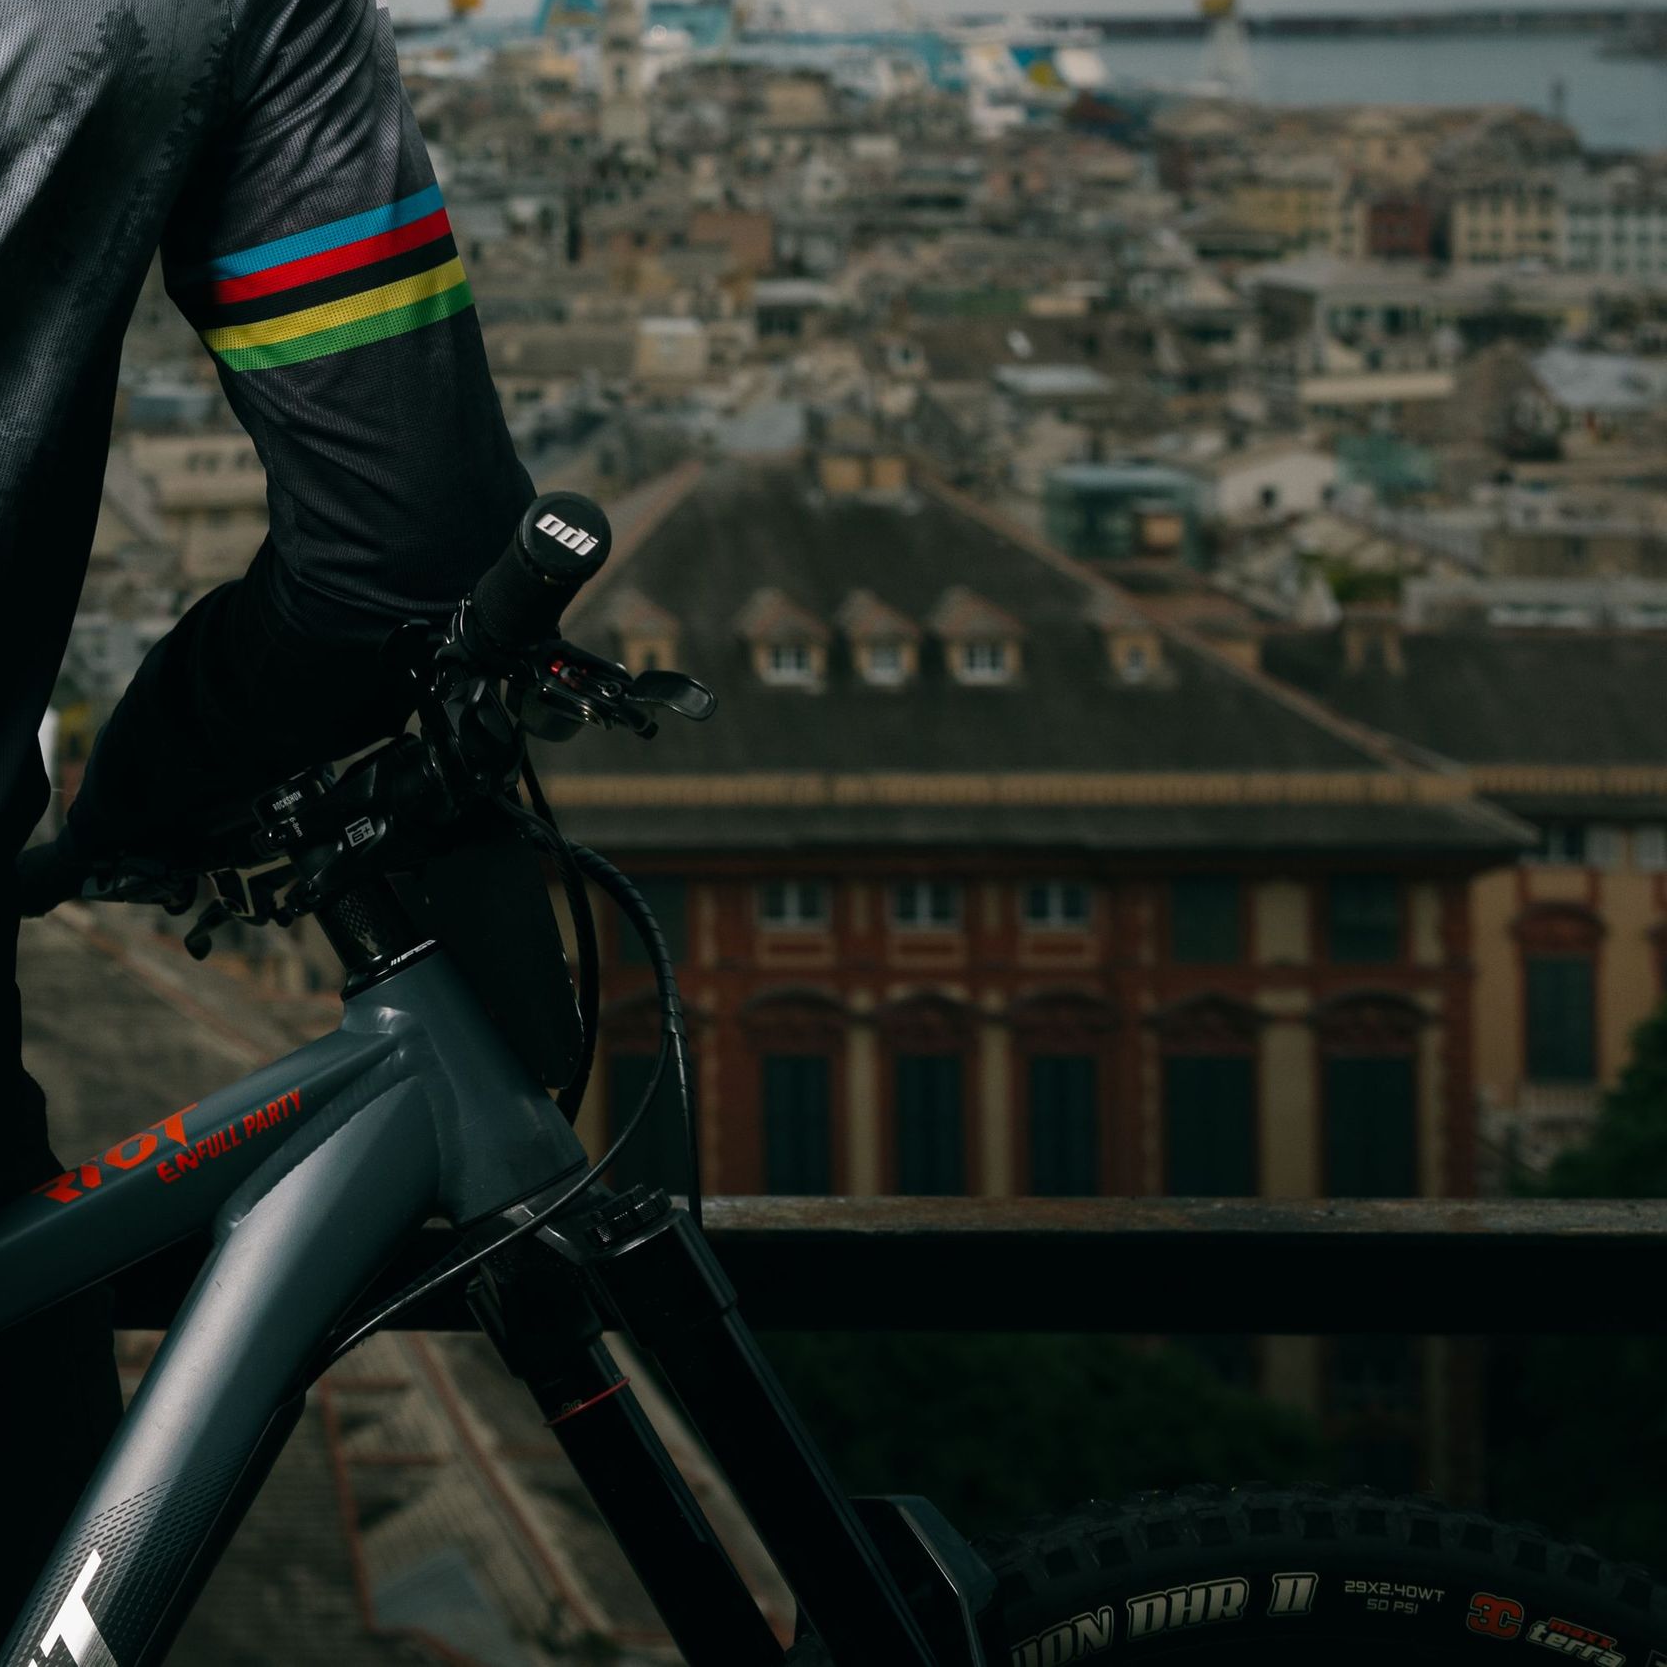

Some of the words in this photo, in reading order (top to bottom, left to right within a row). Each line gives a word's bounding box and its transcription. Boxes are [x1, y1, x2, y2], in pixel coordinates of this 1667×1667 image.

[535, 513, 599, 556] odi
[195, 1123, 243, 1161] FULL
[242, 1086, 303, 1139] PARTY
[1126, 1576, 1251, 1643] DHR
[1393, 1600, 1420, 1616] PSI
[1466, 1591, 1525, 1641] 3C
[1527, 1620, 1626, 1667] terra
